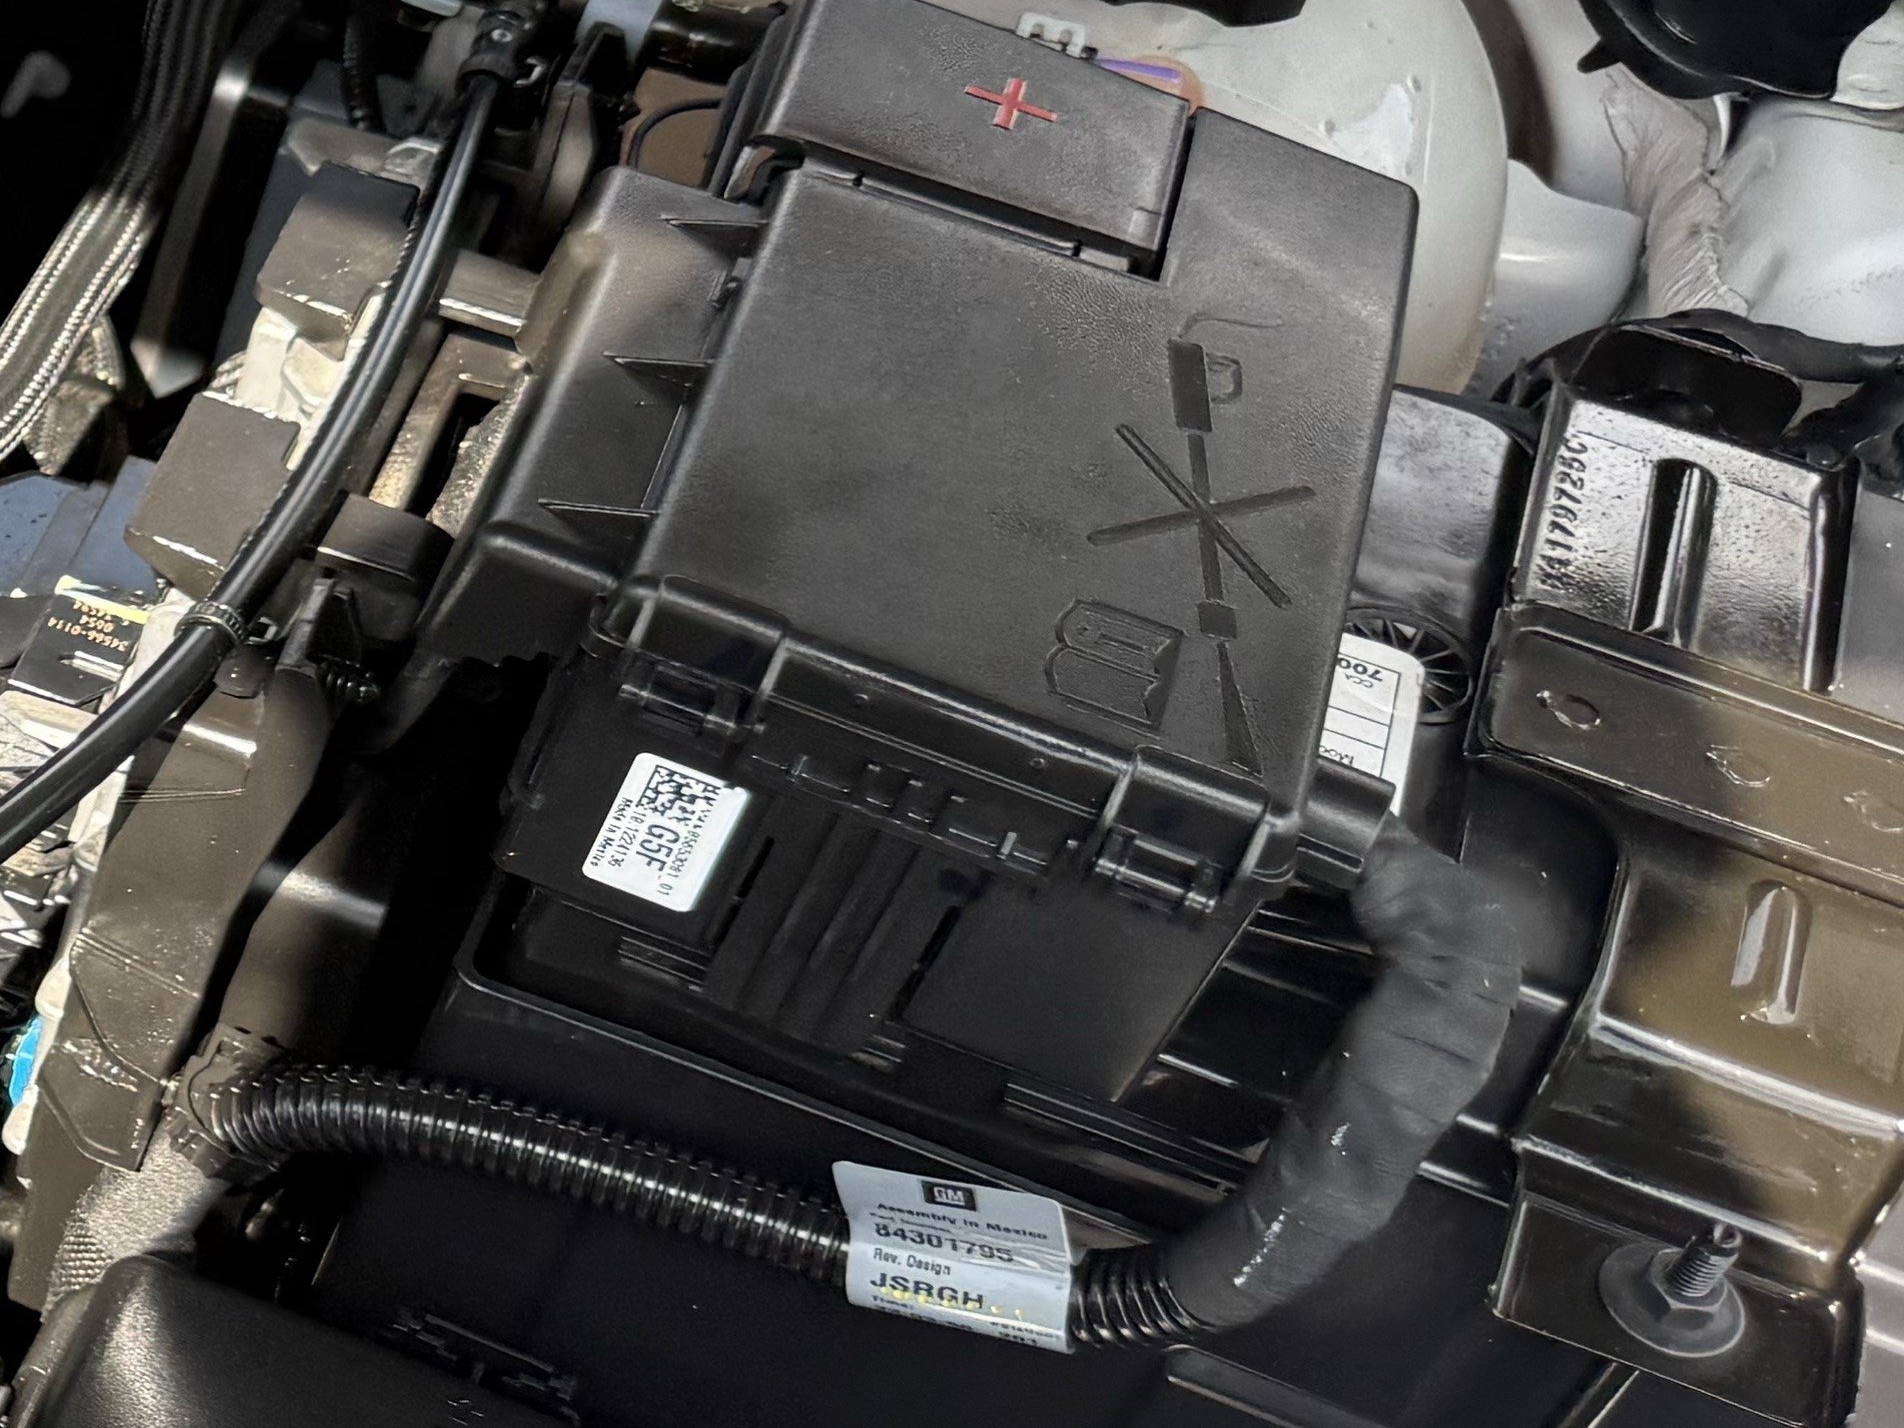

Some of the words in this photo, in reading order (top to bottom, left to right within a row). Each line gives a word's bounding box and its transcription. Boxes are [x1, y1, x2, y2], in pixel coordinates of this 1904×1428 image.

[635, 824, 681, 871] G5F
[934, 1186, 965, 1206] GM
[874, 1223, 1015, 1263] 84301795
[906, 1254, 952, 1276] Design
[870, 1272, 984, 1310] JSRGH
